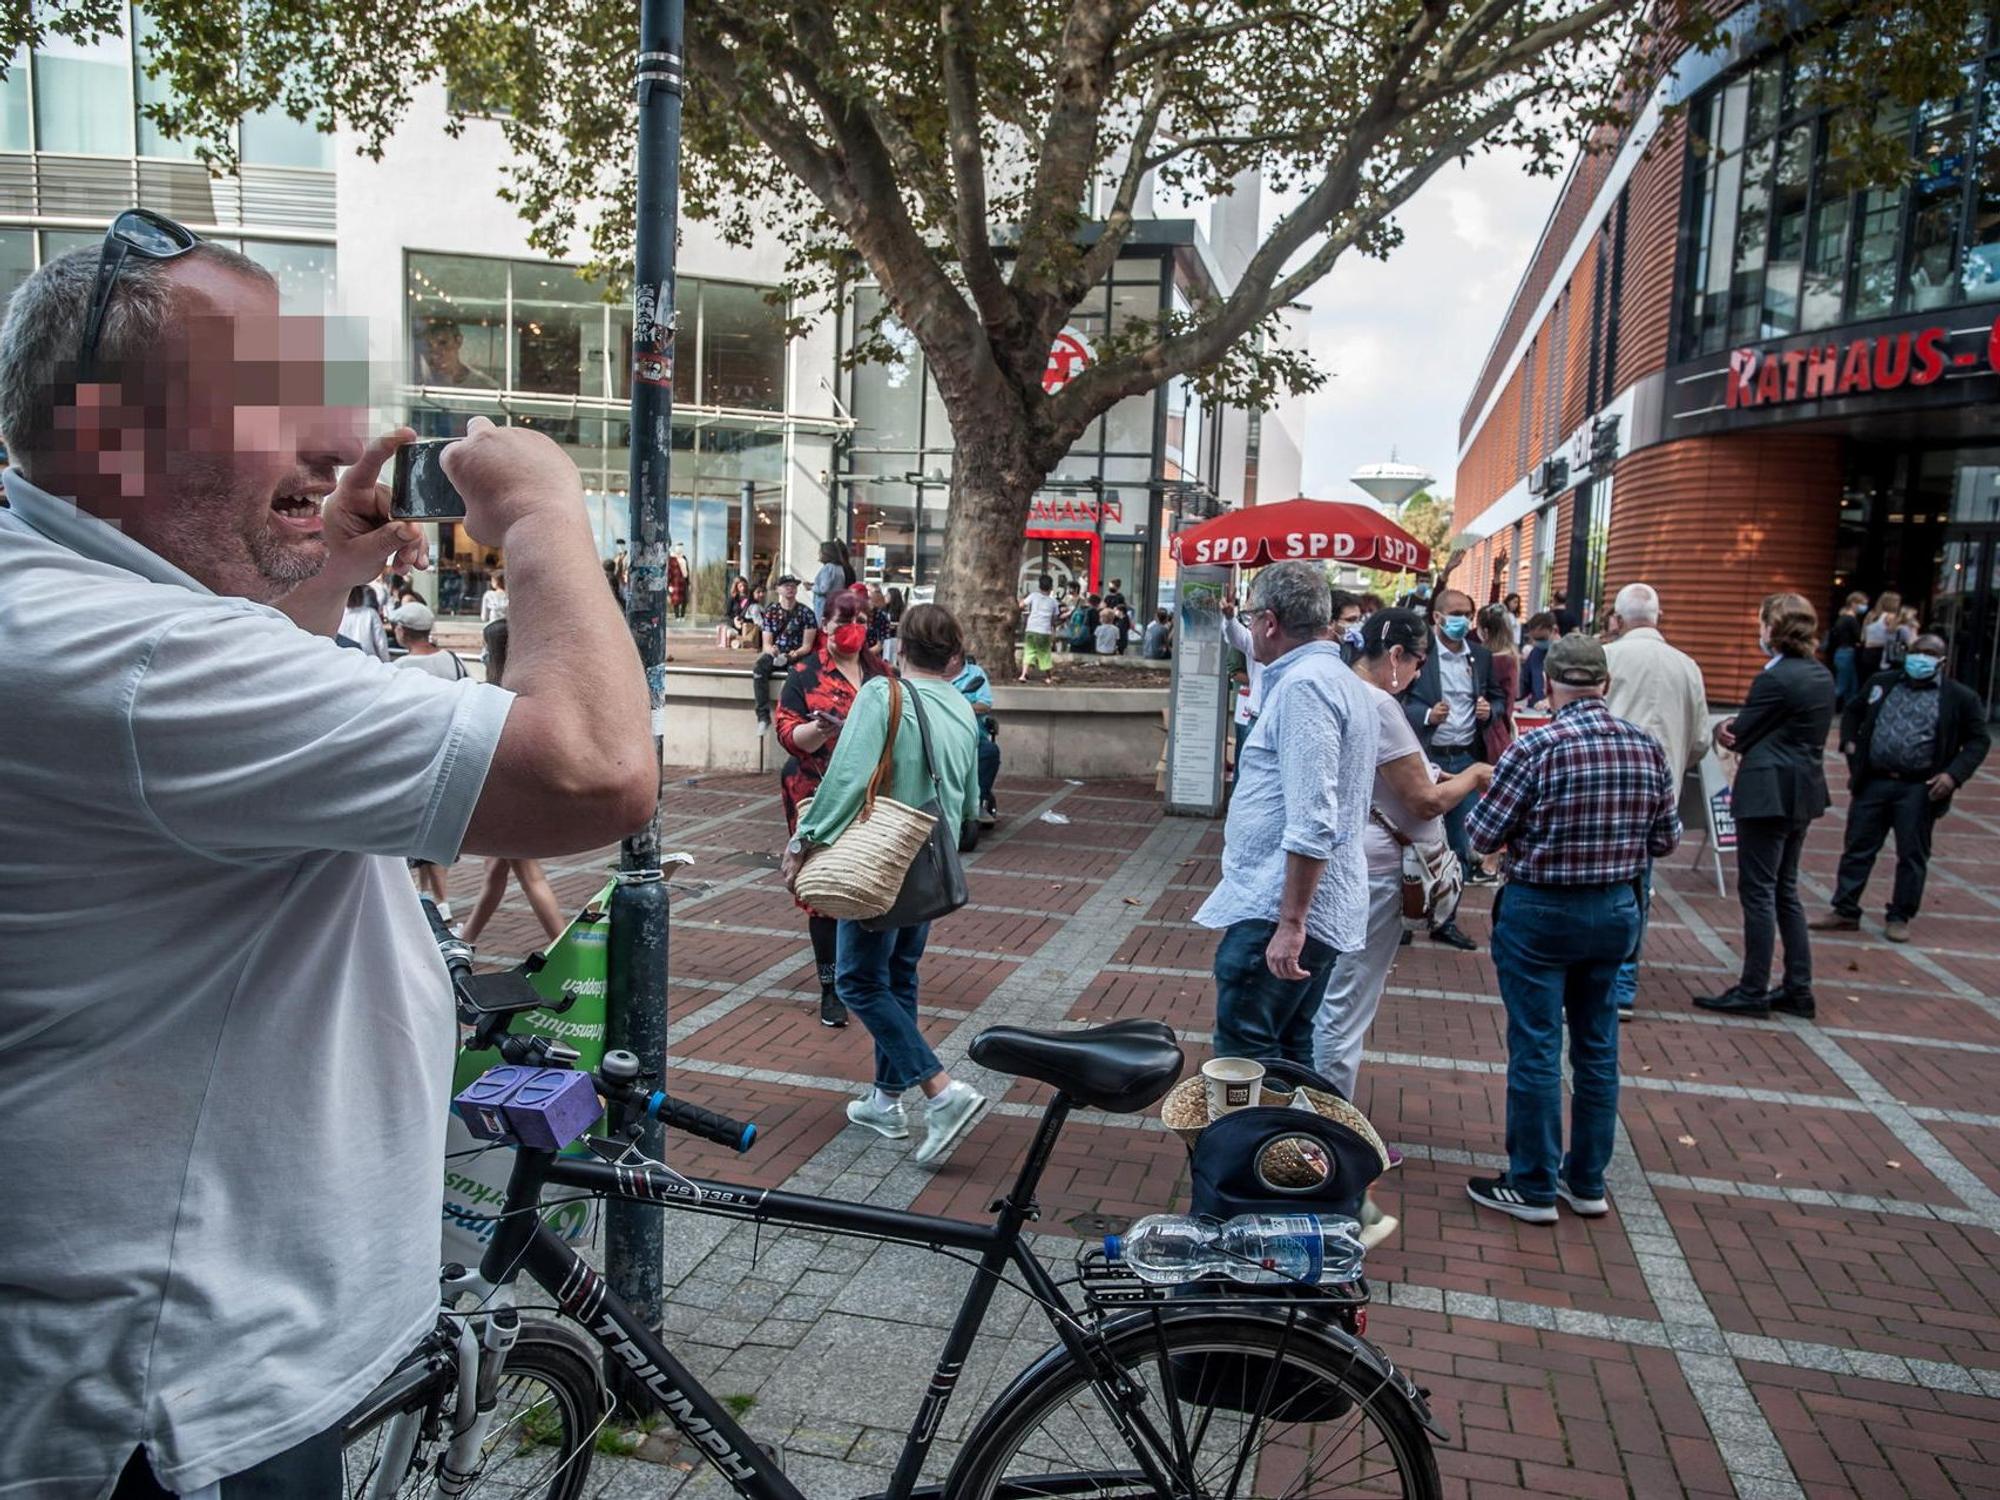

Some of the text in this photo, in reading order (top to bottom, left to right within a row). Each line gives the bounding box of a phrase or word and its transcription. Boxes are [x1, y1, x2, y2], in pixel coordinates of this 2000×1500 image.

[1196, 537, 1248, 563] SPD
[1286, 533, 1355, 557] SPD
[1385, 535, 1418, 565] SPD
[444, 1169, 505, 1206] rkus
[442, 1201, 497, 1242] ima
[594, 1313, 756, 1480] TRIUMPH
